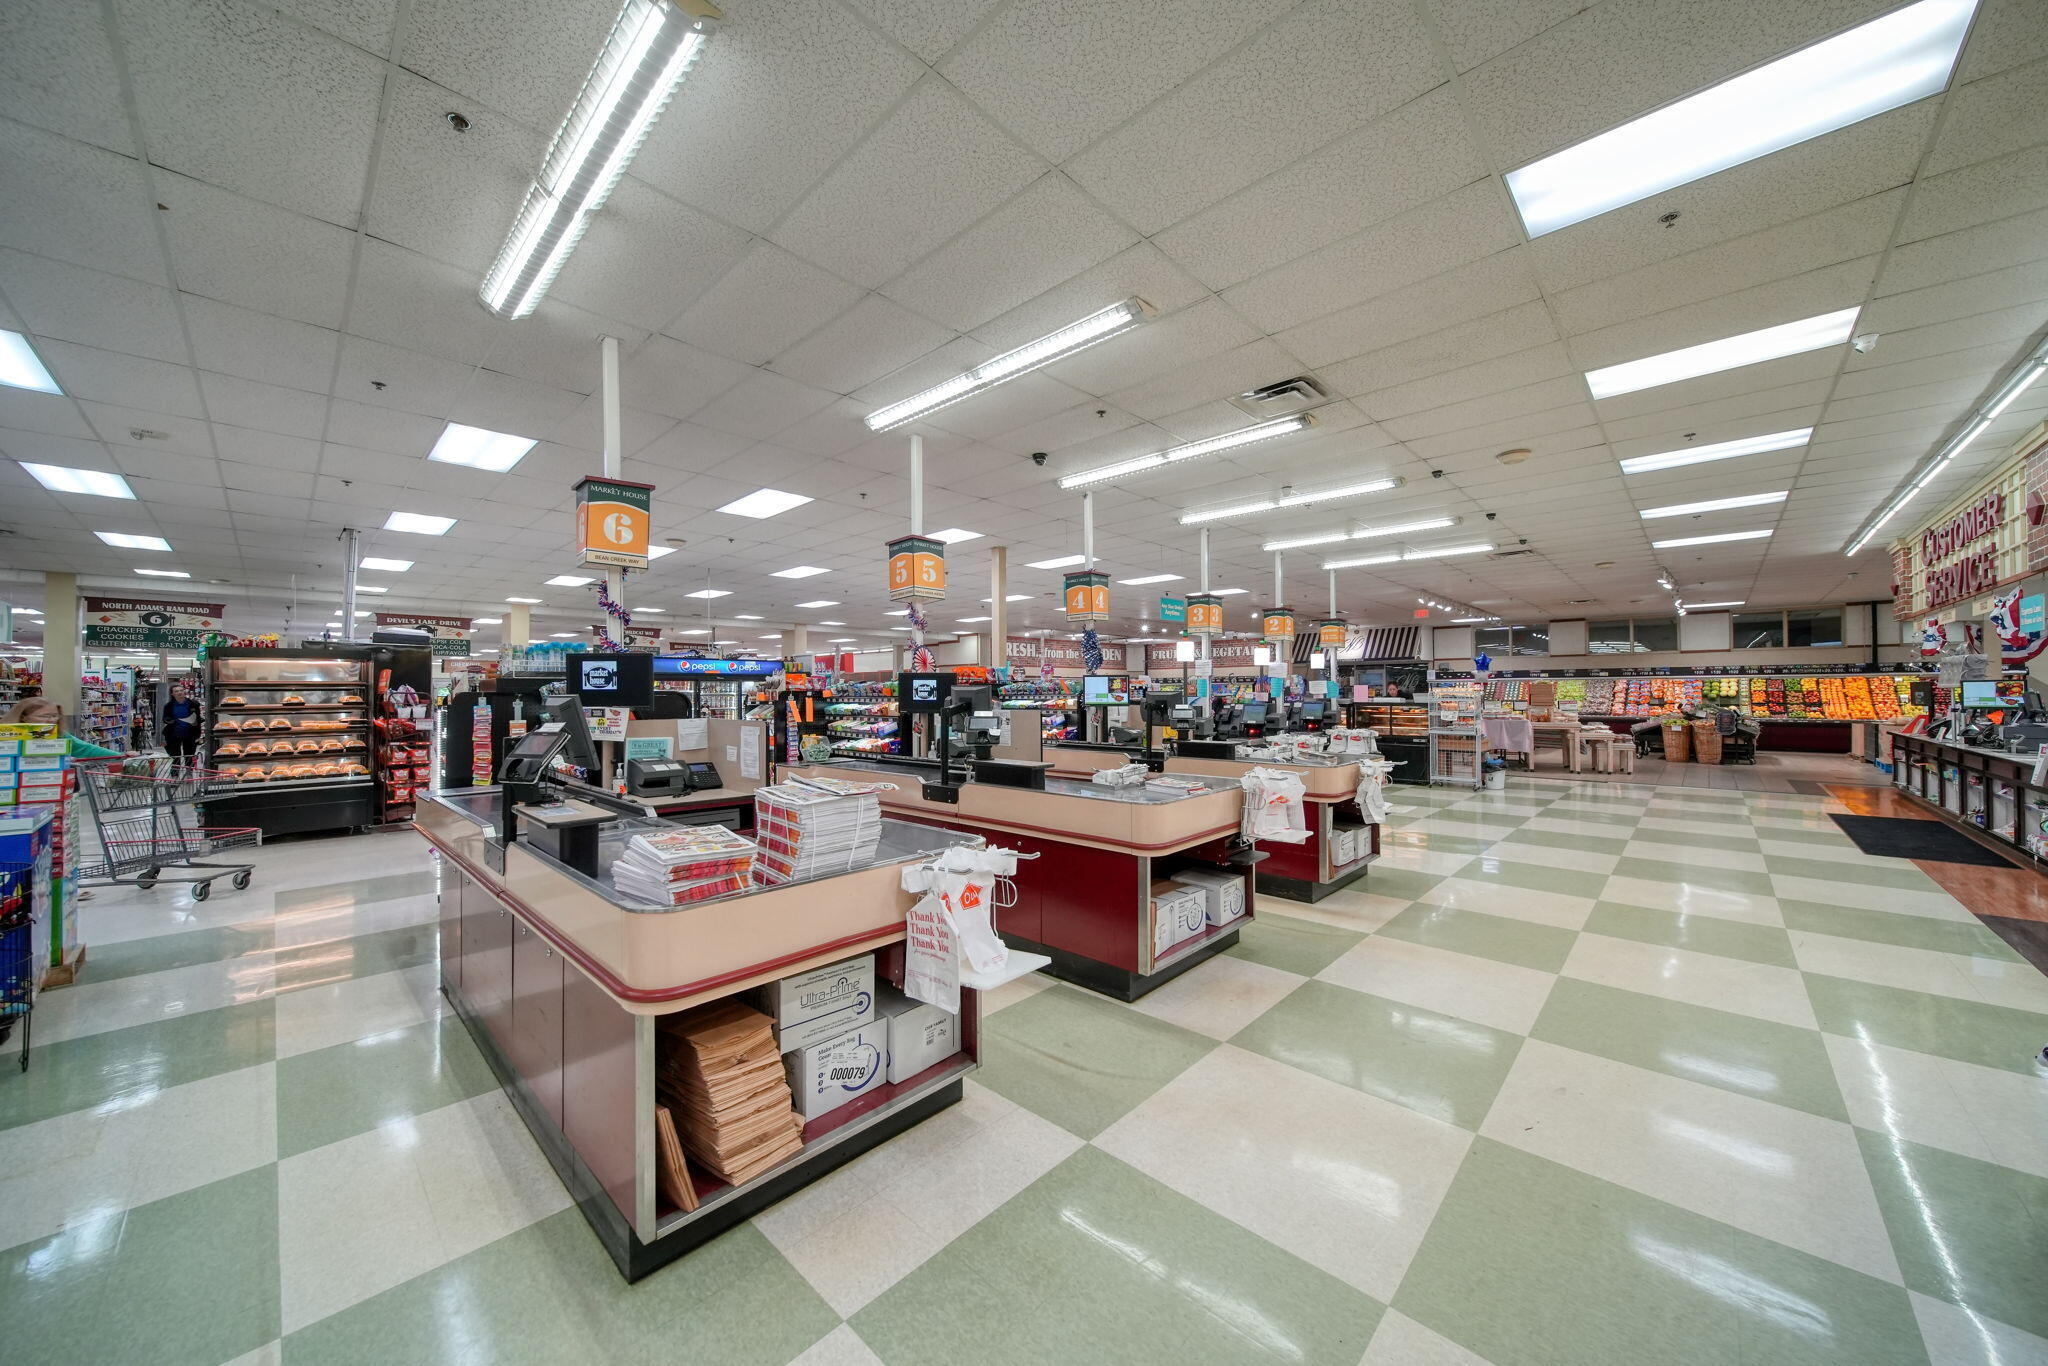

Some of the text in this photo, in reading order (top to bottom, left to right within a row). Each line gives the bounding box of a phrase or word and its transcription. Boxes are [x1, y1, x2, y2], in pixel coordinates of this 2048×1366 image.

[590, 484, 648, 501] MARKET HOUSE
[603, 512, 634, 544] 6
[1921, 494, 2001, 566] CUSTOMER
[896, 560, 907, 584] 5
[922, 560, 936, 582] 5
[1925, 542, 1997, 608] SERVICE
[102, 602, 132, 610] NORTH
[1072, 591, 1085, 609] 4
[1096, 591, 1104, 609] 4
[150, 615, 162, 624] 6
[1193, 608, 1204, 622] 3
[1212, 608, 1219, 622] 3
[97, 626, 149, 634] CRACKERS
[1269, 619, 1279, 631] 2
[1286, 618, 1292, 631] 2
[1044, 648, 1064, 658] from
[1066, 649, 1079, 658] the
[1103, 649, 1122, 660] DEN
[1152, 650, 1177, 659] FRU
[692, 662, 716, 671] pepsi
[739, 664, 761, 672] pepsi
[590, 676, 605, 684] house
[910, 910, 934, 924] Thank
[910, 923, 949, 939] Thank You
[911, 936, 950, 953] Thank You
[800, 978, 860, 1007] Ultra-Prime
[818, 1047, 832, 1055] Make
[833, 1040, 847, 1050] Every
[830, 1066, 866, 1081] 000079
